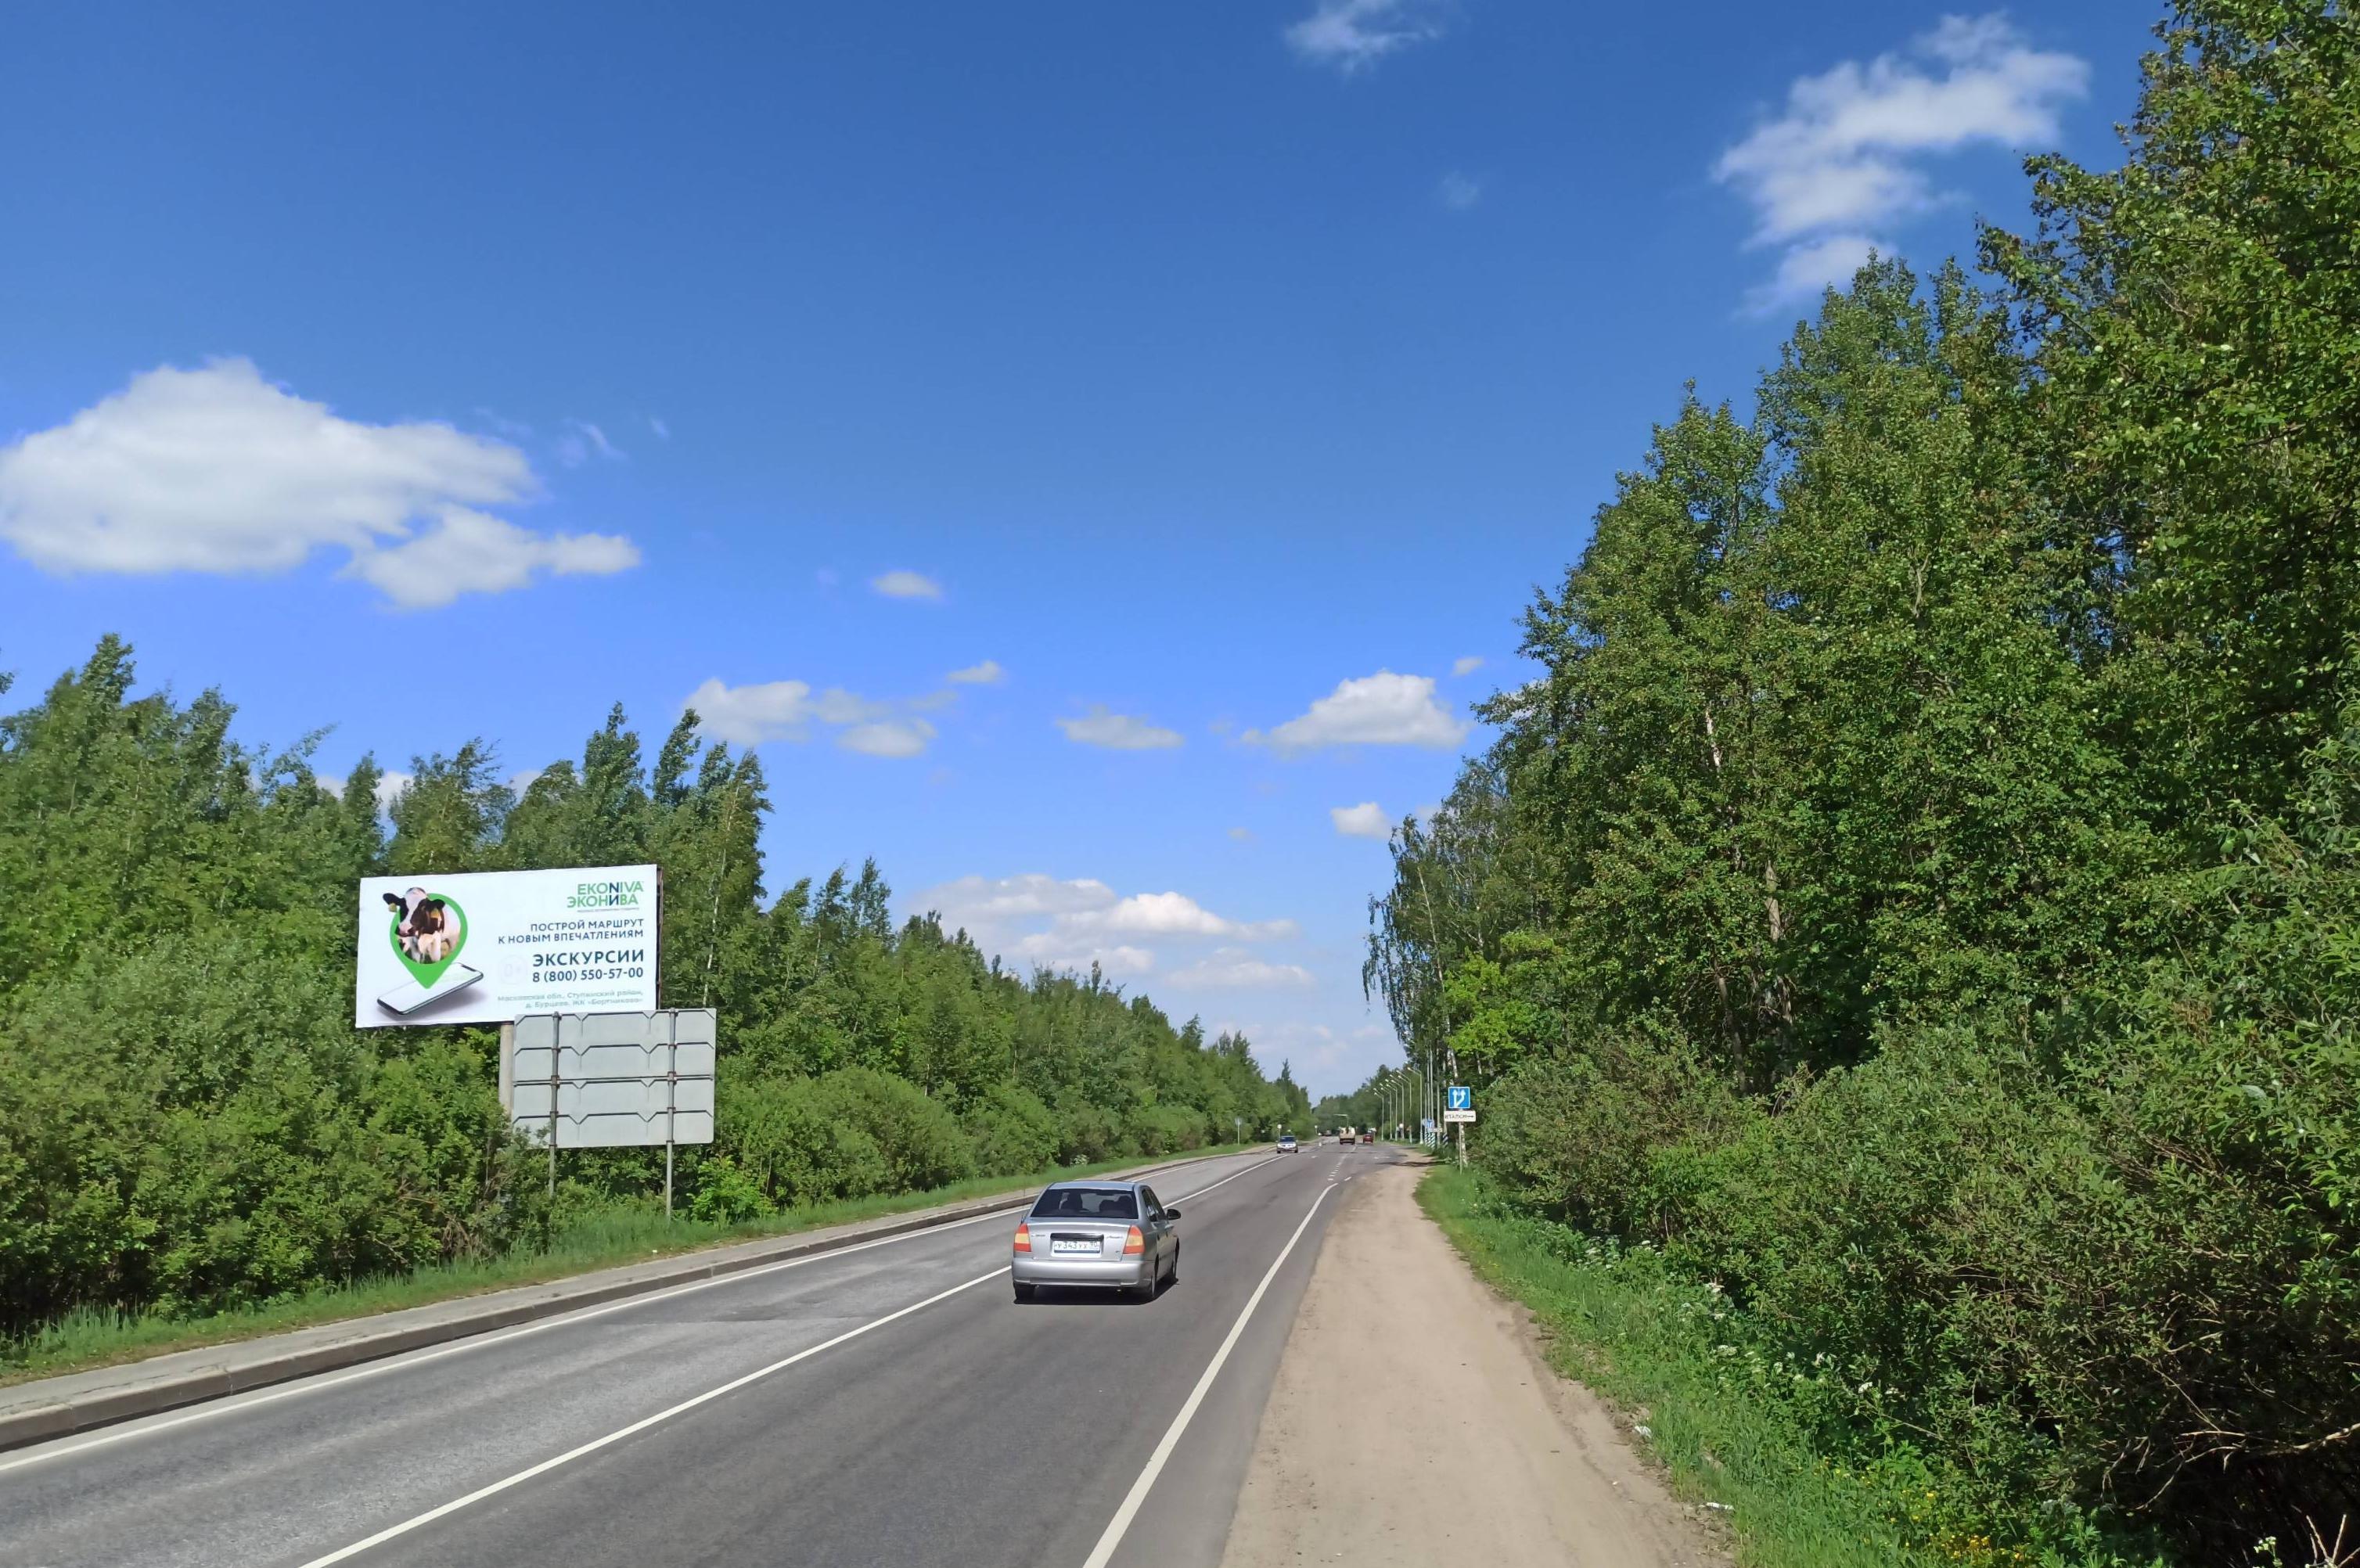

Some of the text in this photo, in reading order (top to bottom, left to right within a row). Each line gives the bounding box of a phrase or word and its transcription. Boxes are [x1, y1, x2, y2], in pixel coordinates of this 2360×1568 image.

[577, 881, 644, 895] EKONIVA
[567, 894, 639, 908] ЭКОНИВА
[531, 919, 644, 932] ПОСТРОЙ МАРШРУТ
[509, 933, 552, 944] НОВЫМ
[555, 930, 644, 942] ВПЕЧАТЛЕНИЯМ
[533, 949, 644, 967] ЭКСКУРСИИ
[533, 967, 644, 983] 8 (800) 550-57-00
